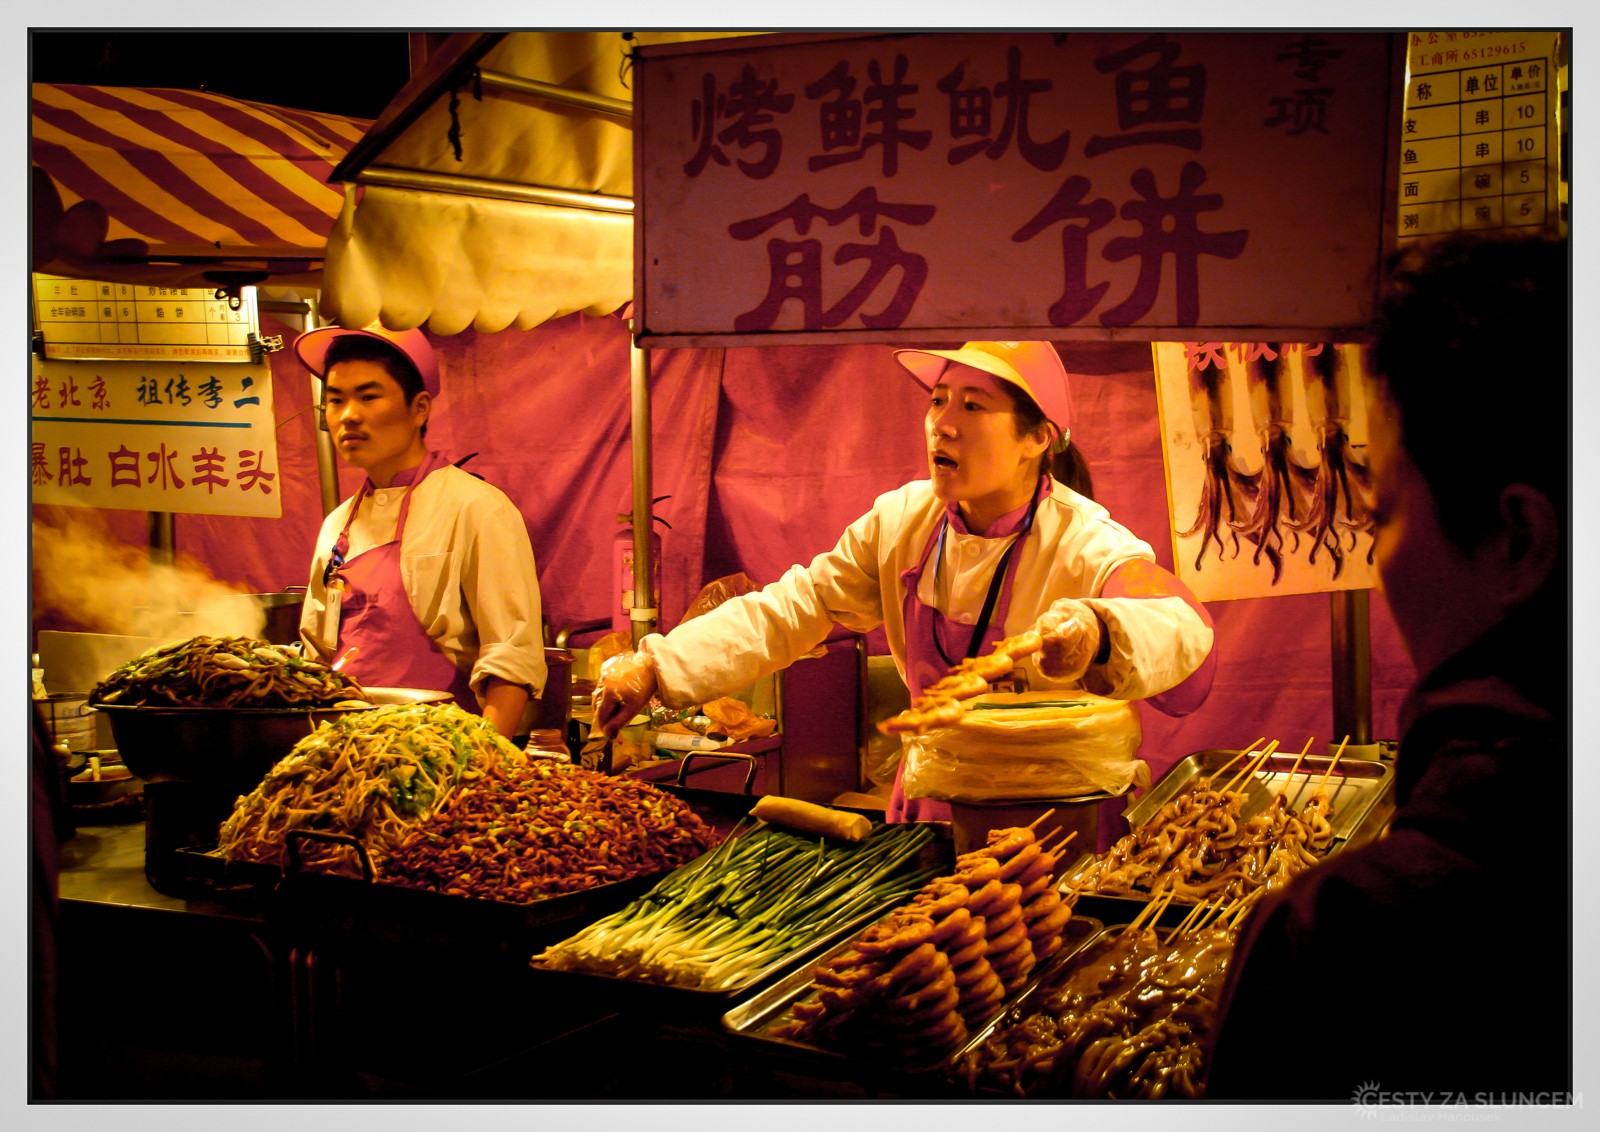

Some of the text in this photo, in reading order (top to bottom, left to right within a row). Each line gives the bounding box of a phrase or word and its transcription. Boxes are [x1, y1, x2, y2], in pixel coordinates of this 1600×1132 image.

[1463, 42, 1526, 60] 65129615
[1263, 33, 1345, 136] 专项
[1465, 74, 1499, 95] 单位
[1510, 64, 1541, 81] 单价
[1416, 82, 1432, 101] 称
[683, 33, 1206, 180] 烤鲜鱿鱼
[1475, 109, 1490, 125] 串
[1517, 104, 1535, 119] 10
[1403, 137, 1535, 165] 鱼 串 10
[1404, 181, 1419, 197] 面
[1520, 169, 1530, 184] 5
[1520, 202, 1530, 217] 5
[727, 161, 1250, 331] 筋饼
[32, 373, 261, 411] 老北京 祖传李二
[108, 442, 276, 495] 白水羊头
